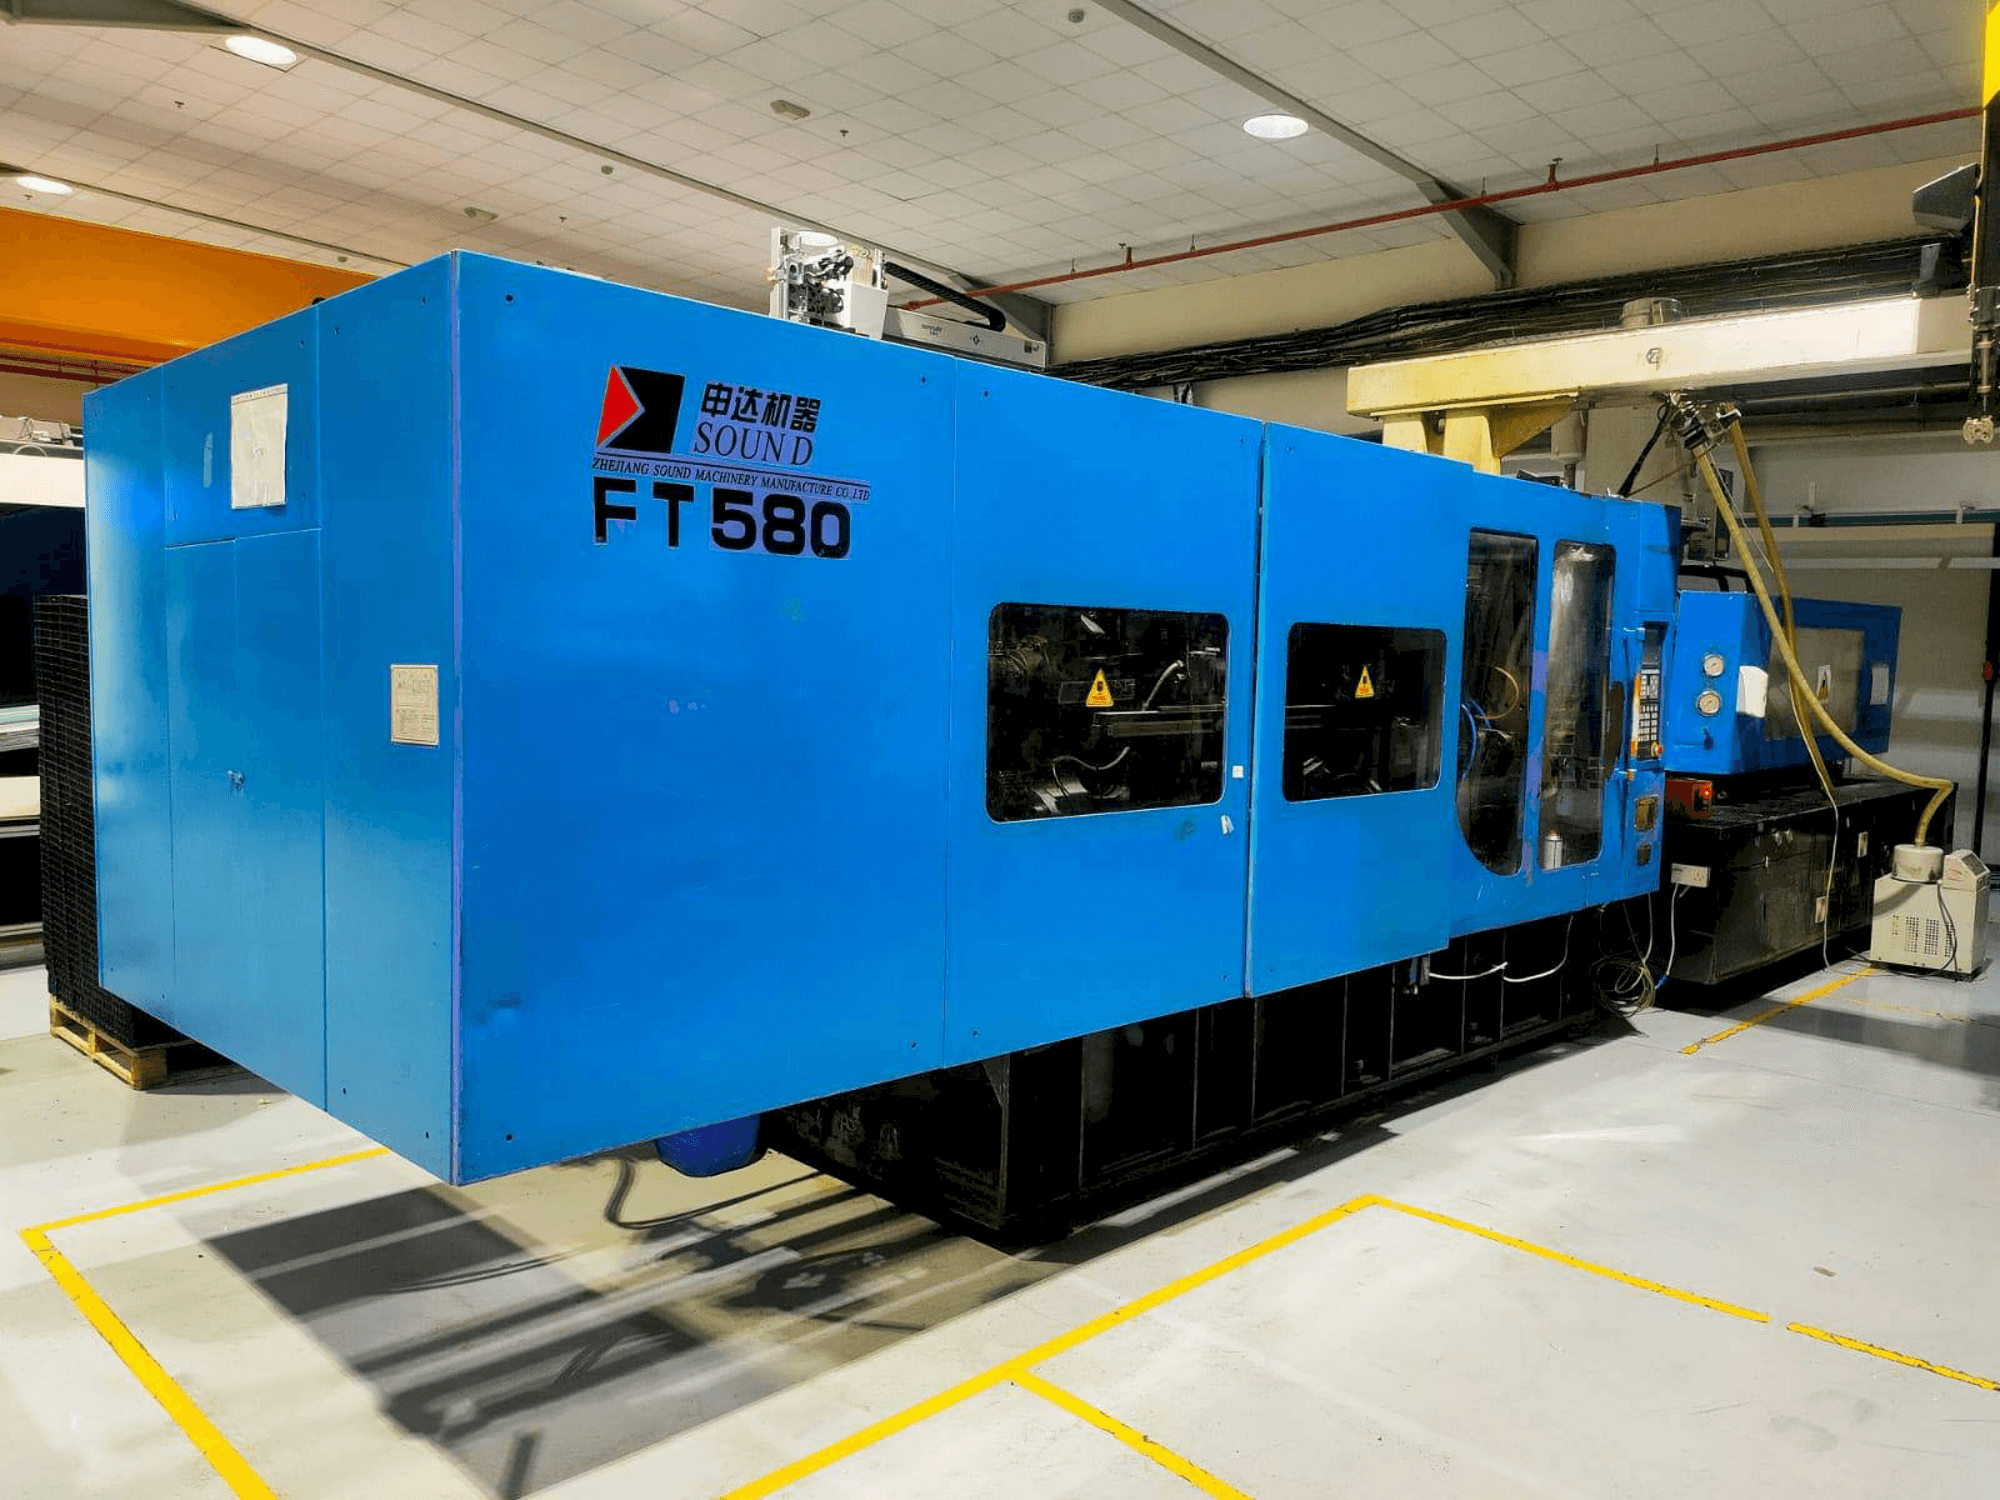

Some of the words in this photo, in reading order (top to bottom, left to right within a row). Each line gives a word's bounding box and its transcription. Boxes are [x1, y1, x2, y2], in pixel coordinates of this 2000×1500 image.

[702, 383, 821, 433] 申达机器
[694, 421, 813, 466] SOUND
[592, 457, 650, 475] ZHEJIANG
[653, 464, 692, 479] SOUND
[695, 468, 758, 487] MACHINERY
[760, 476, 833, 497] MANUFACTURE
